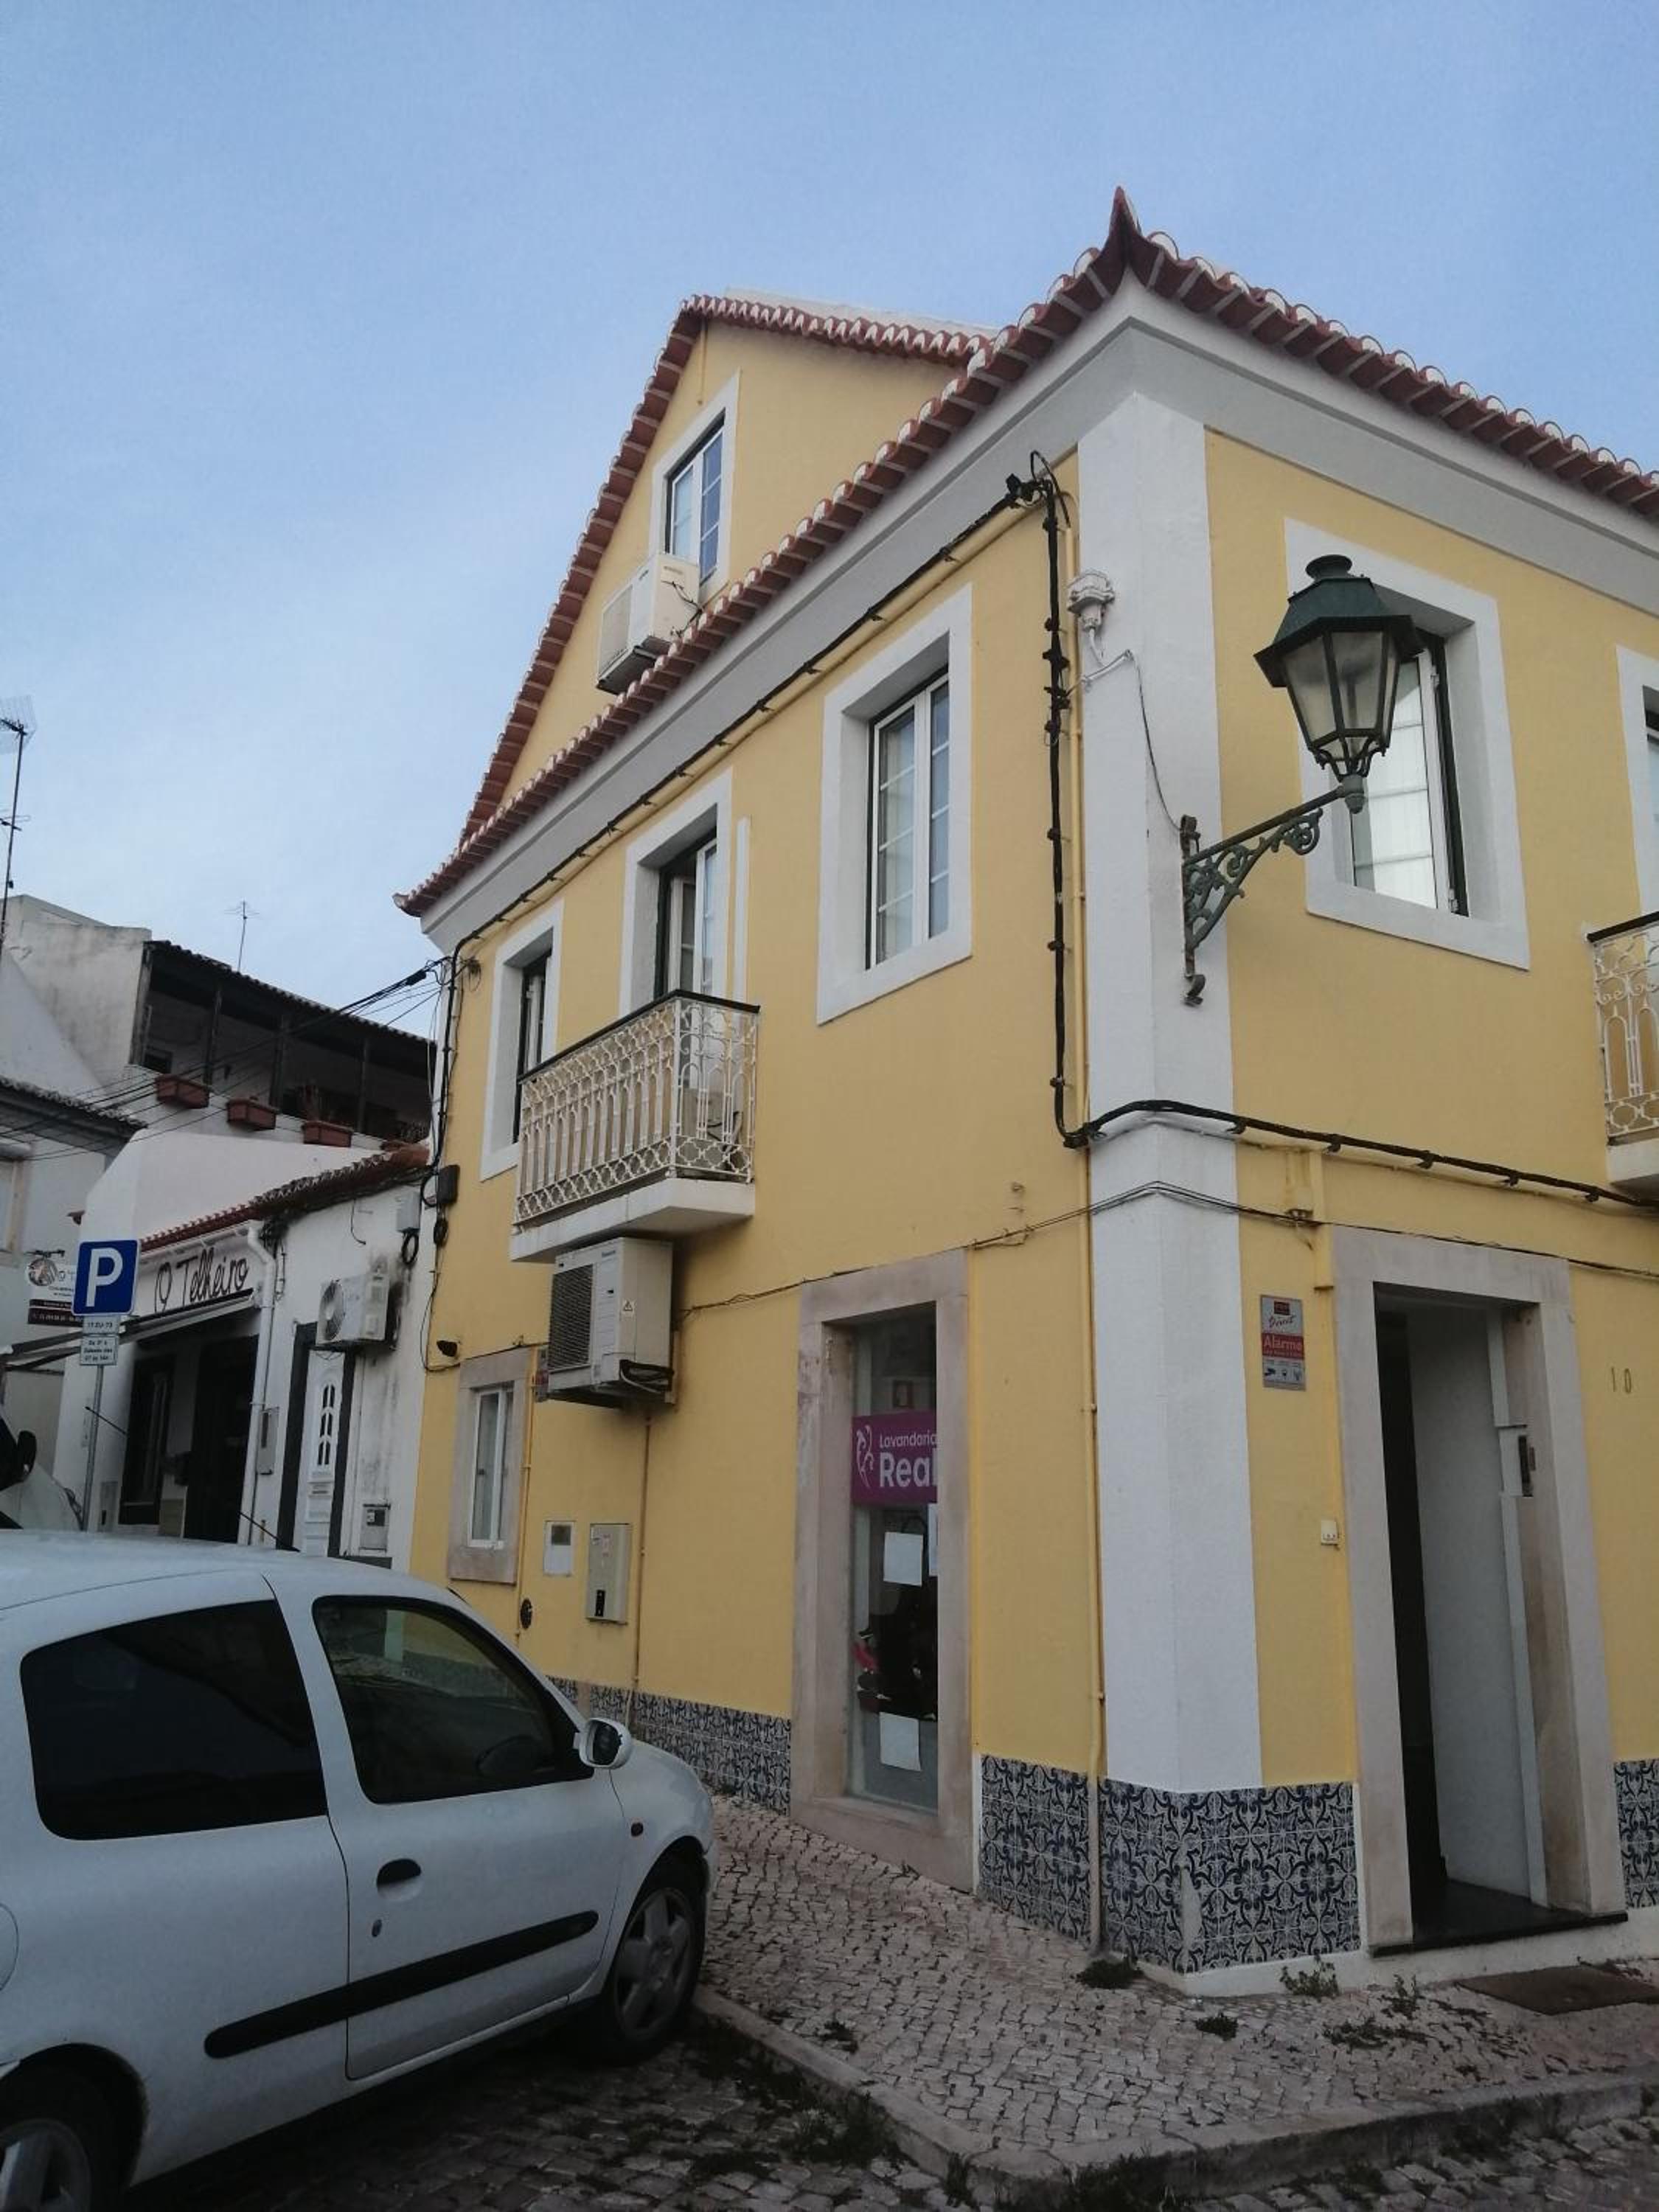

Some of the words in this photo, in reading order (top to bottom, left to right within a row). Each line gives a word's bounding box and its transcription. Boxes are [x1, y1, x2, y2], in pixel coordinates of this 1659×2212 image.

[86, 1247, 123, 1307] P
[175, 1246, 249, 1309] Telheiro
[1263, 1336, 1302, 1352] Alarme
[1611, 1366, 1632, 1394] 10
[880, 1447, 938, 1487] Real
